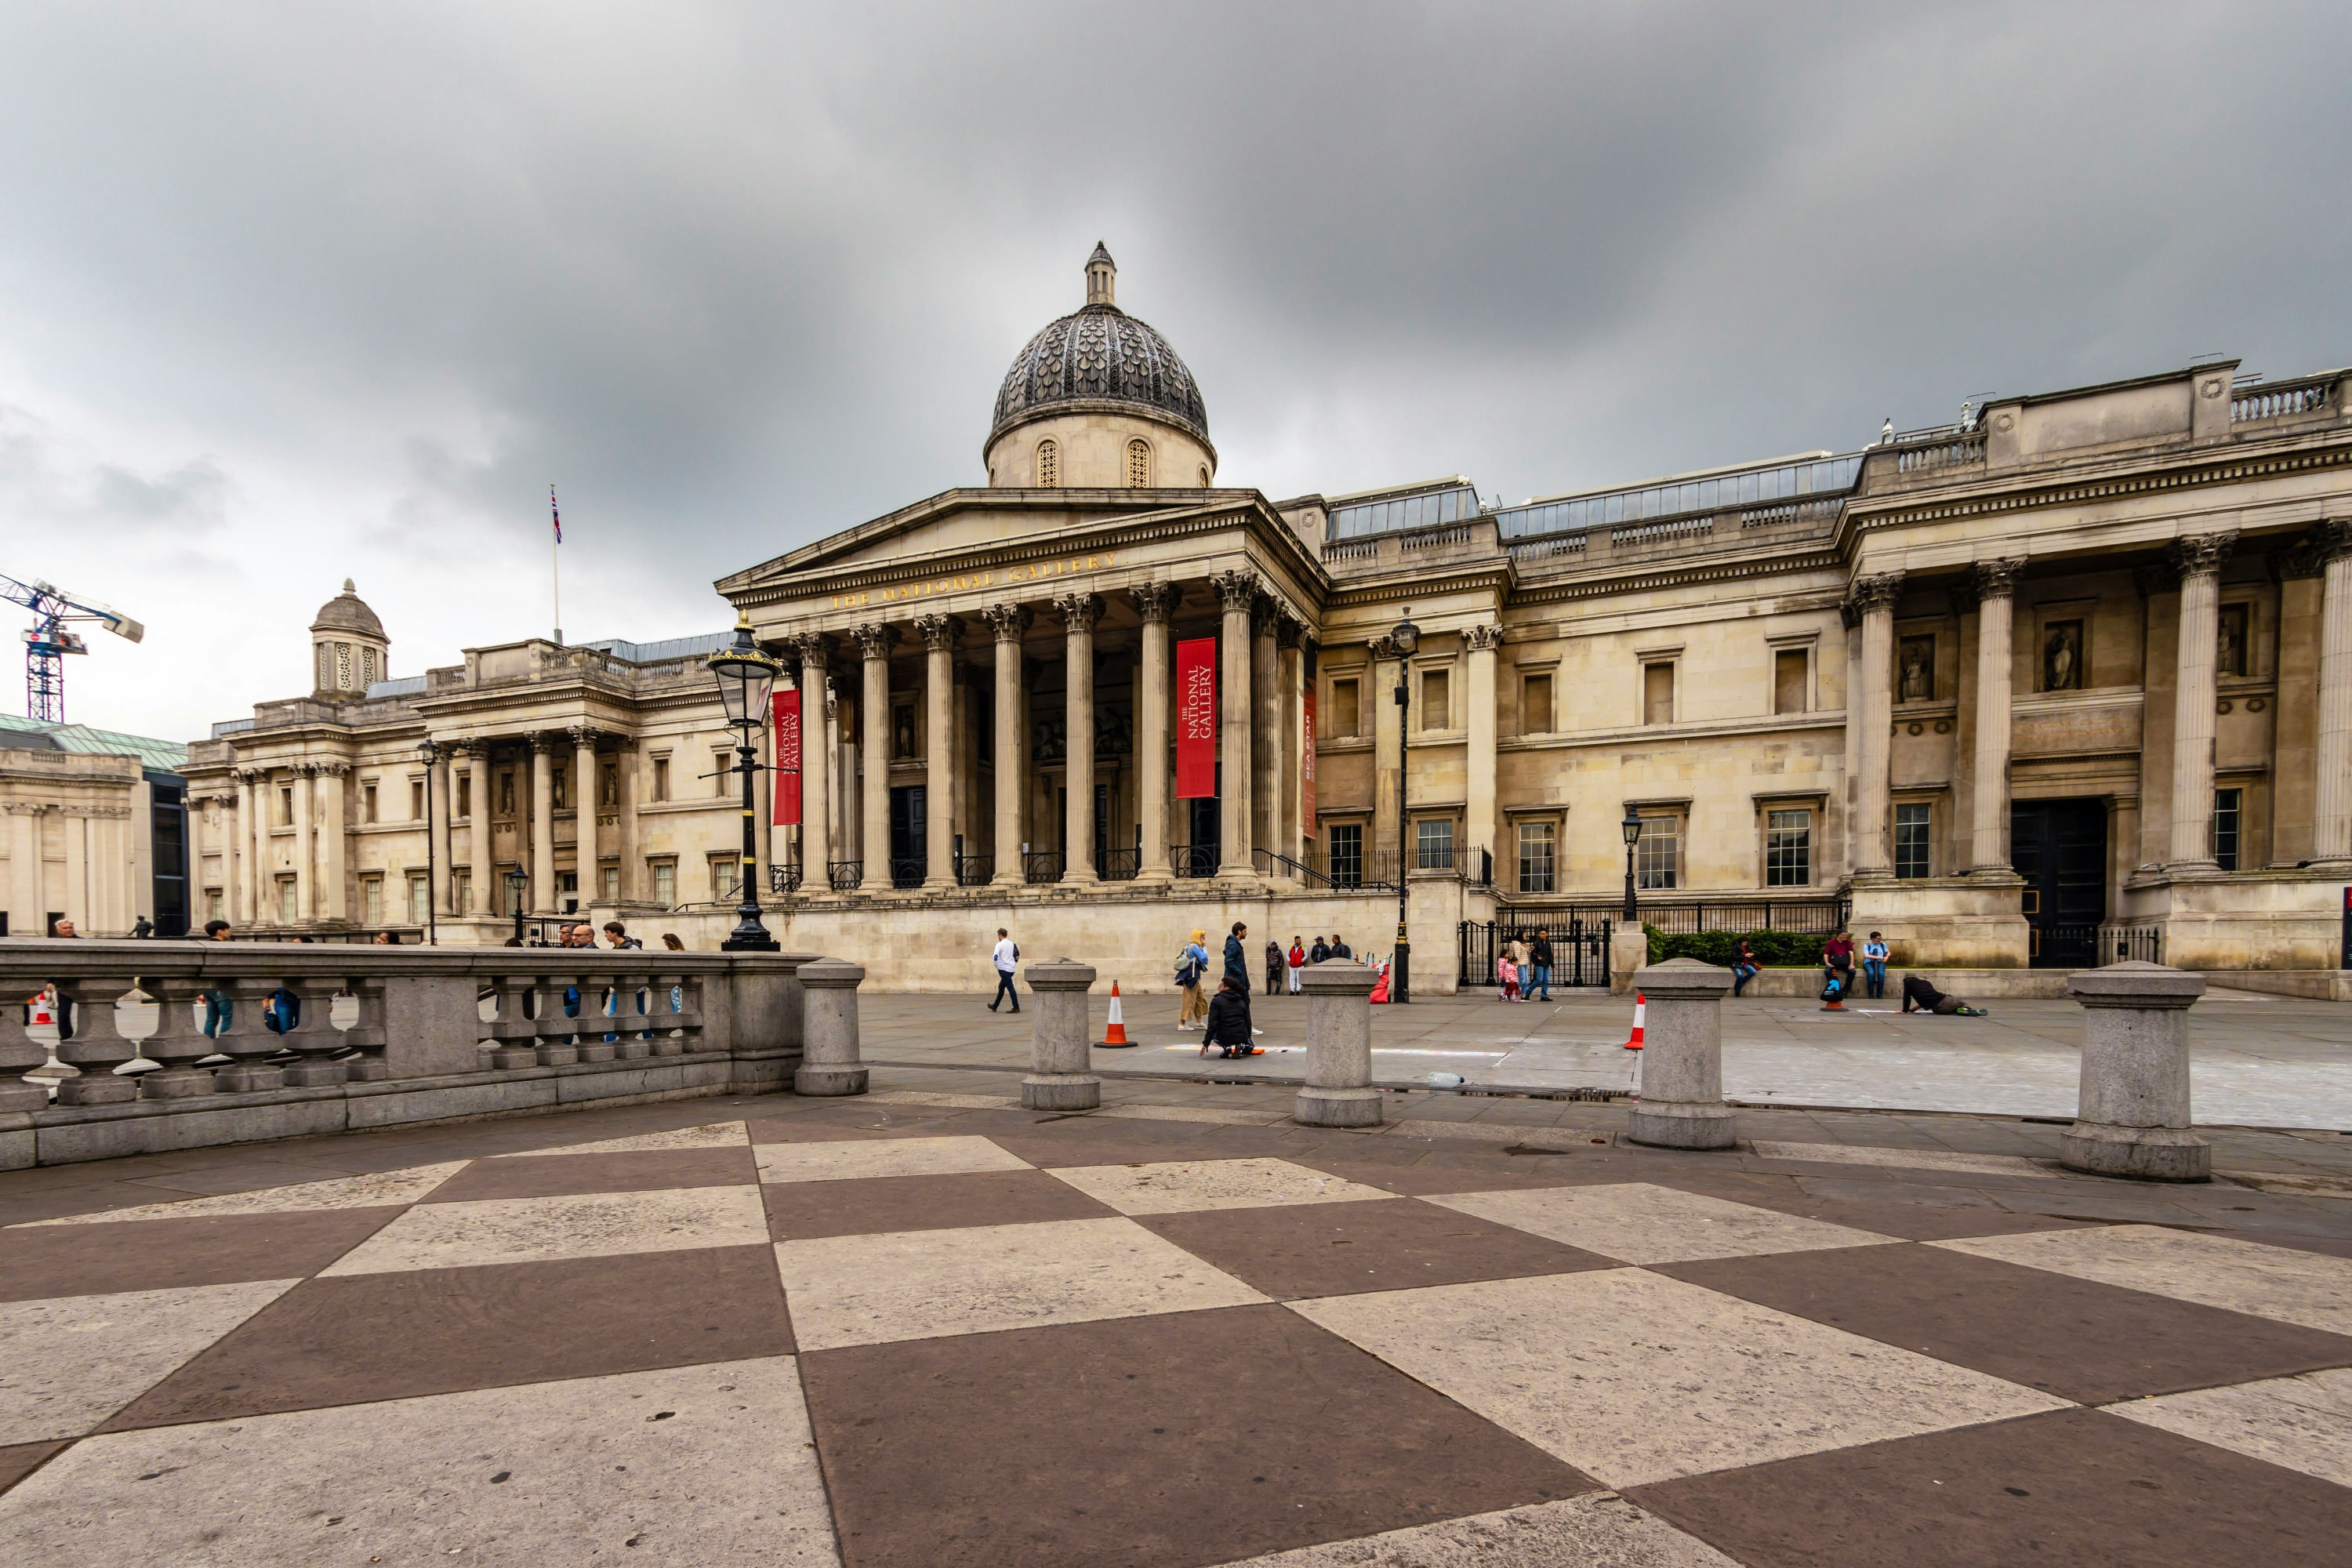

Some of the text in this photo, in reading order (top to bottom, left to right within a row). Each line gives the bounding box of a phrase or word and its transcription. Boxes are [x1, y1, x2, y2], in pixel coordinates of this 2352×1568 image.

[830, 552, 1116, 610] THE NATIONAL GALLERY
[1189, 665, 1199, 739] NATIONAL
[1200, 665, 1211, 739] GALLERY
